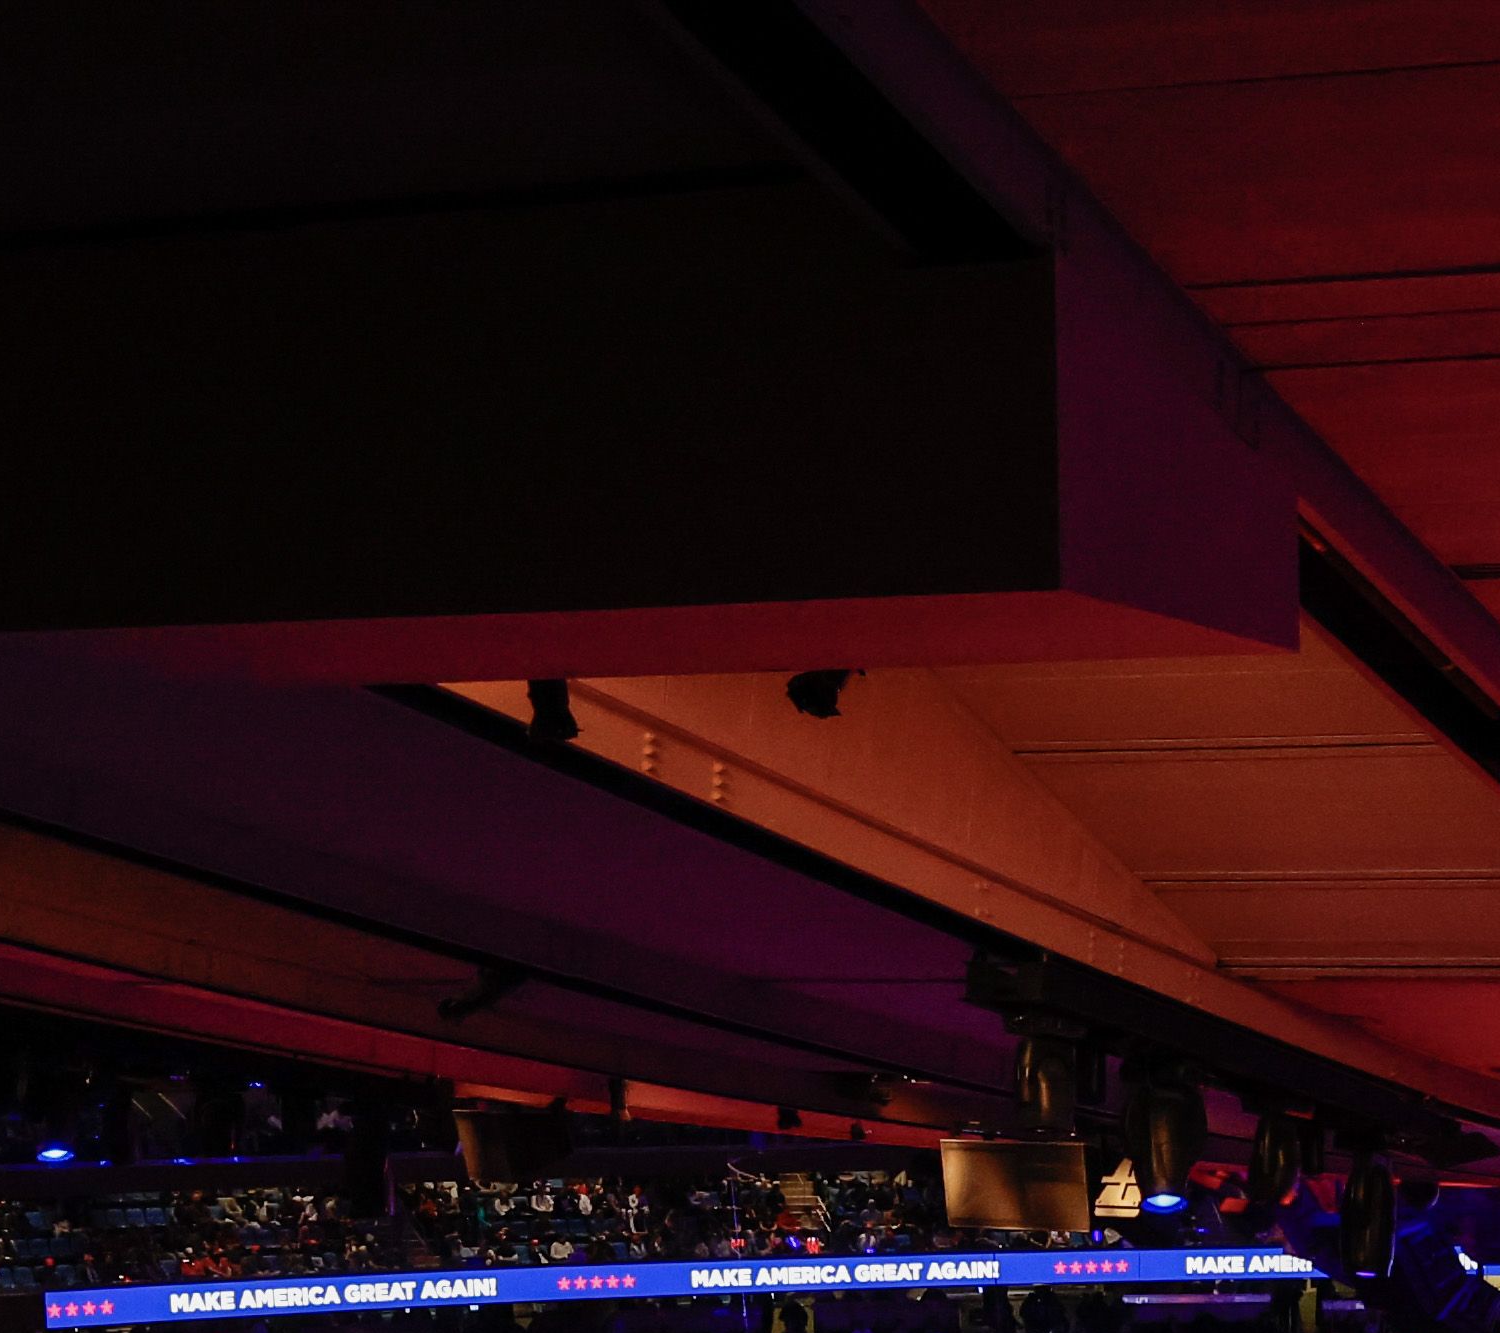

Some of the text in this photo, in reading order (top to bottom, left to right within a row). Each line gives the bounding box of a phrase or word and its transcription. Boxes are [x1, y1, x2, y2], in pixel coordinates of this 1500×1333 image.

[691, 1260, 1000, 1288] MAKE AMERICA GREAT AGAIN!
[1186, 1256, 1245, 1275] MAKE
[169, 1278, 498, 1313] MAKE AMERICA GREAT AGAIN!
